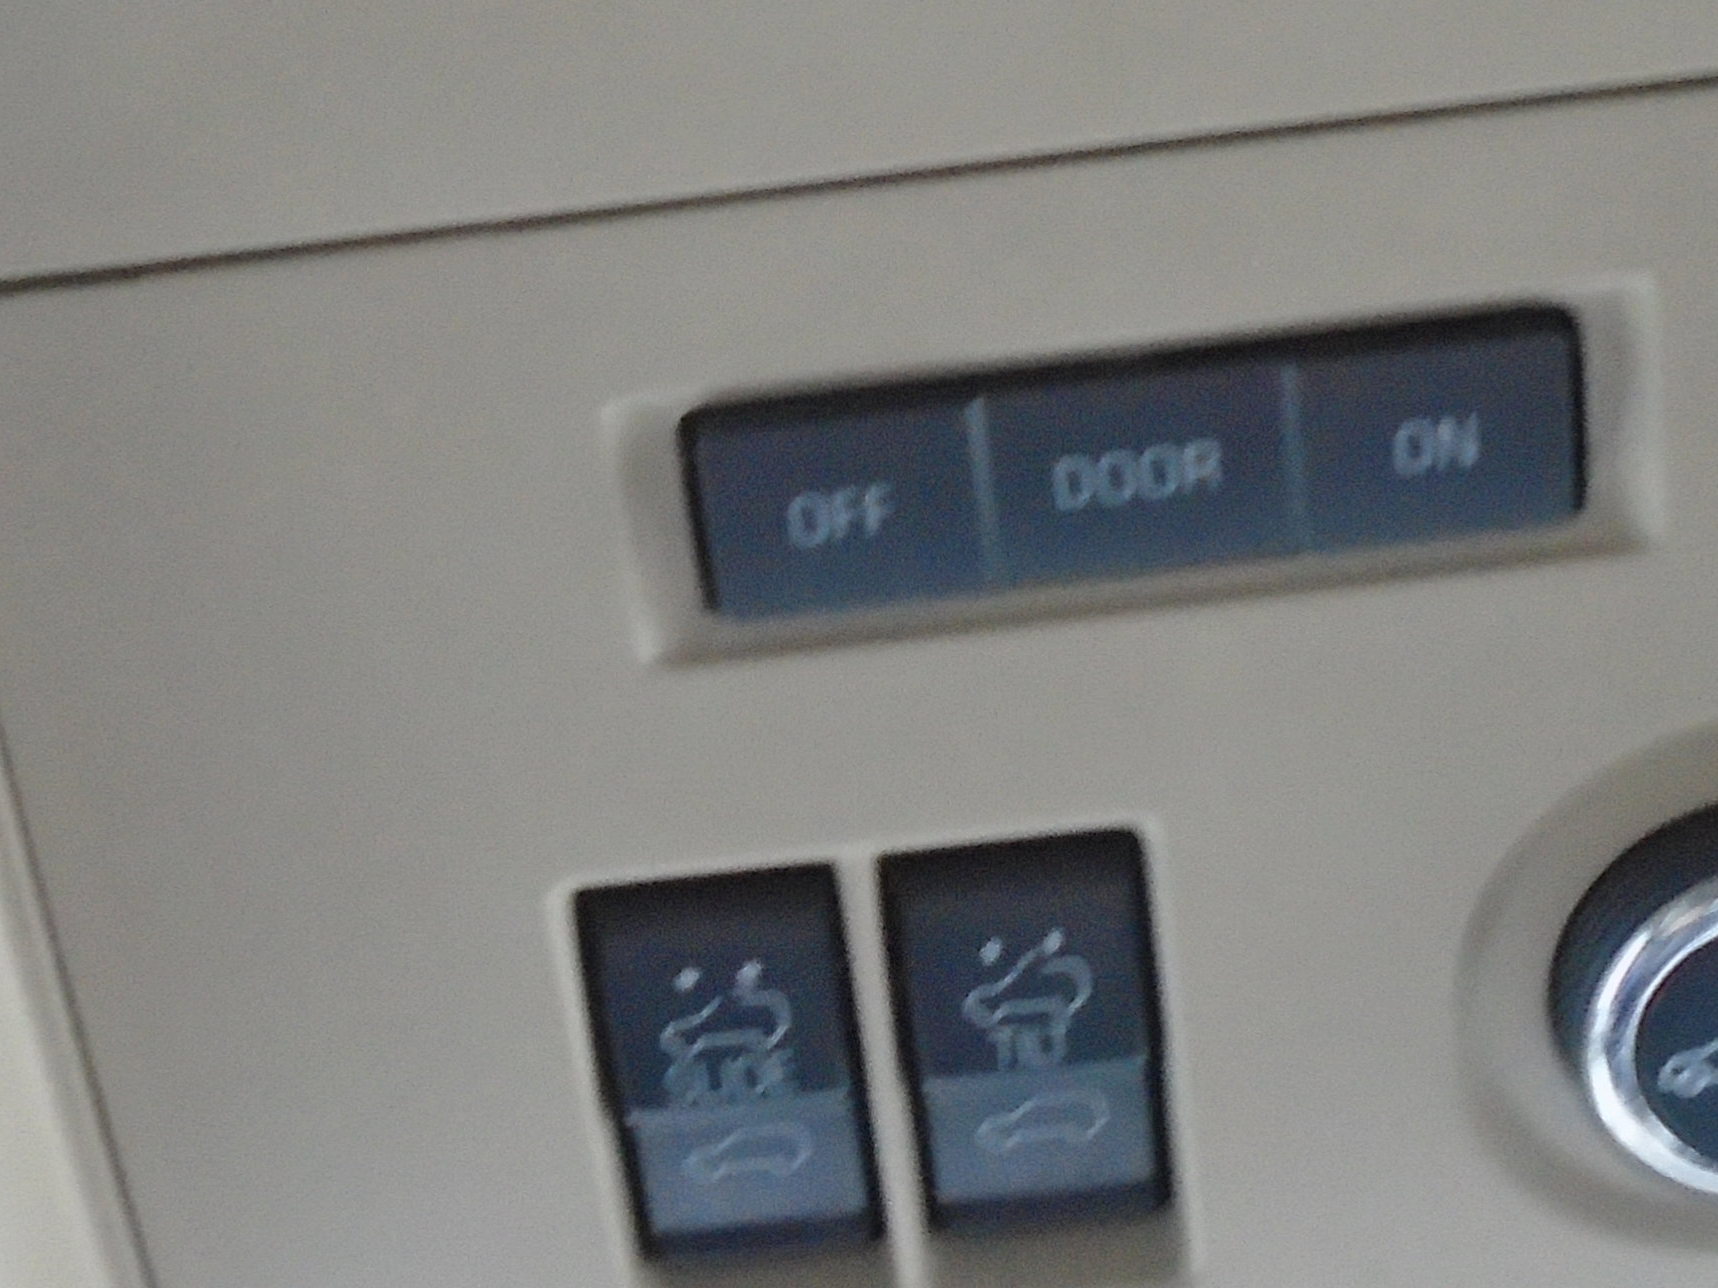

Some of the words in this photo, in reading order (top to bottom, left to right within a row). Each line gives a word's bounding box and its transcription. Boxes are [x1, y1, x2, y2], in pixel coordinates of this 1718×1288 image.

[1051, 437, 1225, 513] DOOR
[1391, 411, 1481, 479] ON
[785, 481, 897, 550] OFF
